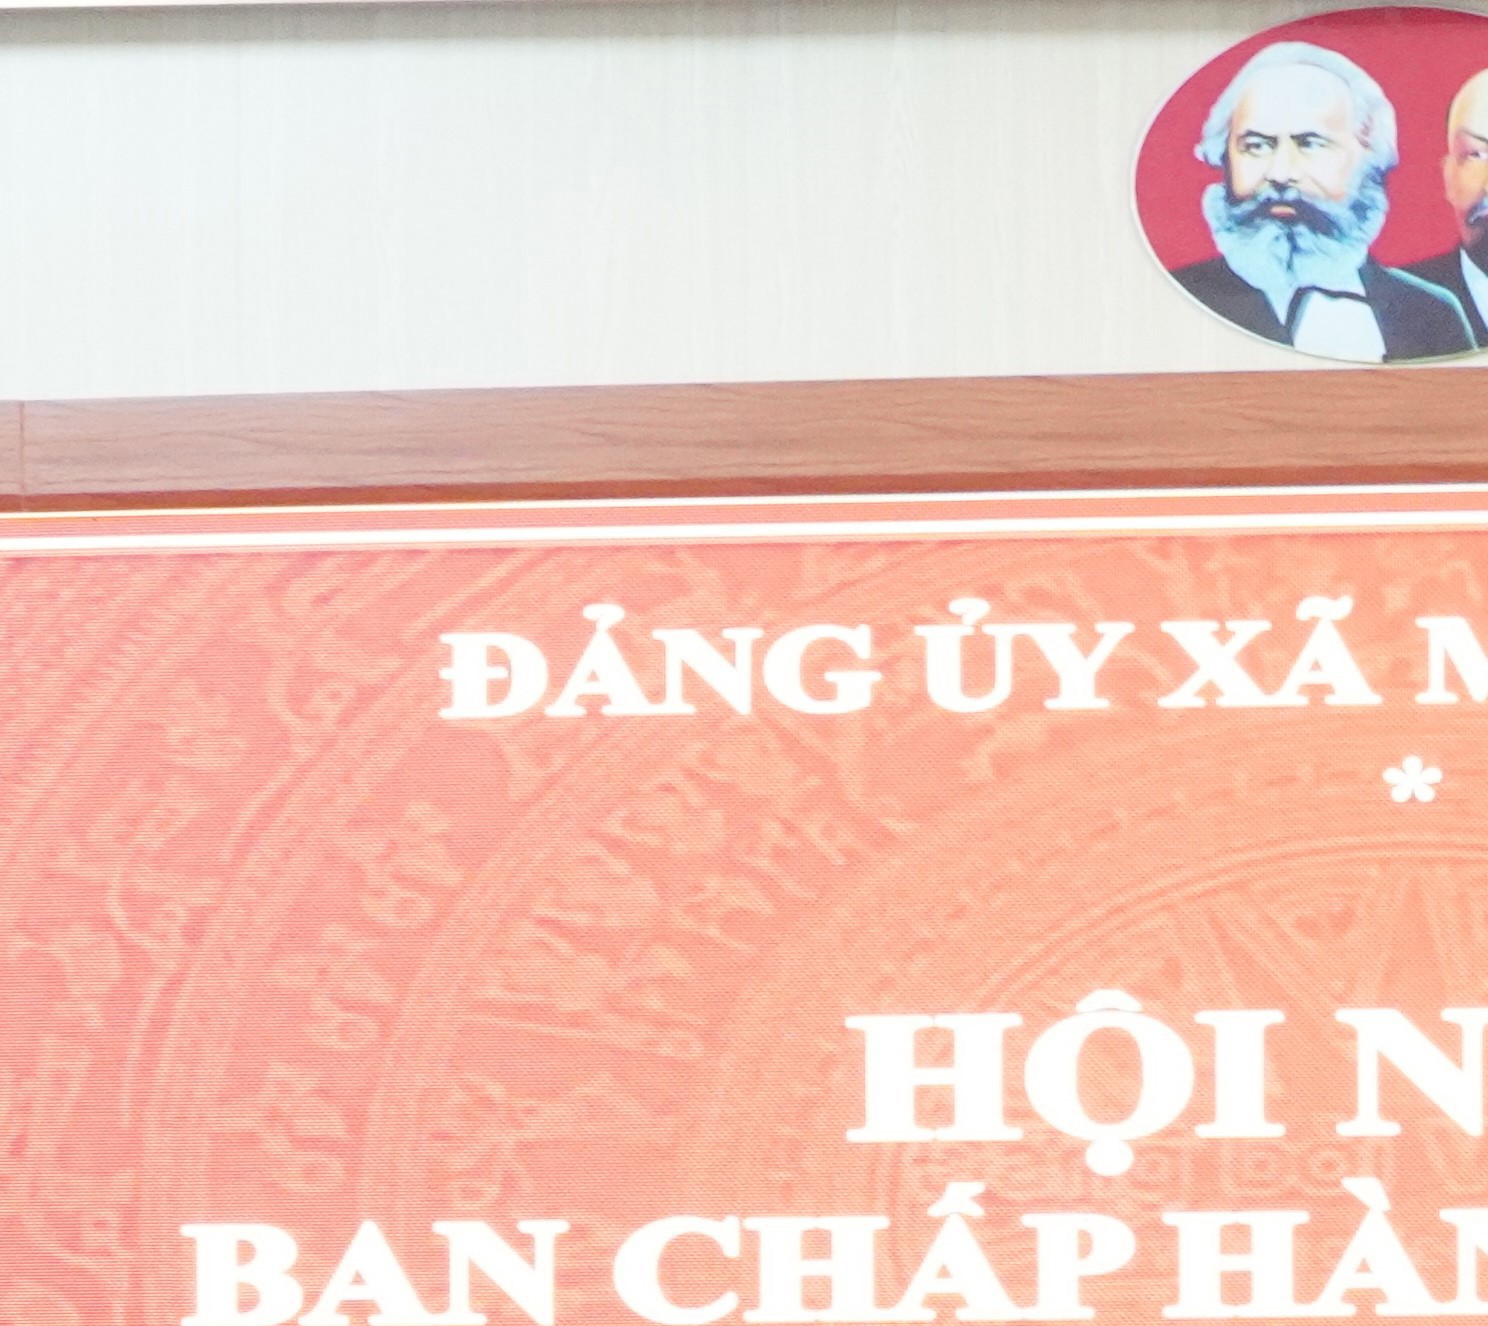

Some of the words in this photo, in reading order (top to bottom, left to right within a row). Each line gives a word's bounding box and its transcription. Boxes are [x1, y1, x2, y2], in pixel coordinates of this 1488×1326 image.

[437, 602, 883, 720] ĐẢNG
[914, 596, 1135, 713] ỦY
[1157, 594, 1383, 709] XÃ
[843, 987, 1286, 1177] HỘI
[611, 1180, 1137, 1326] CHẤP
